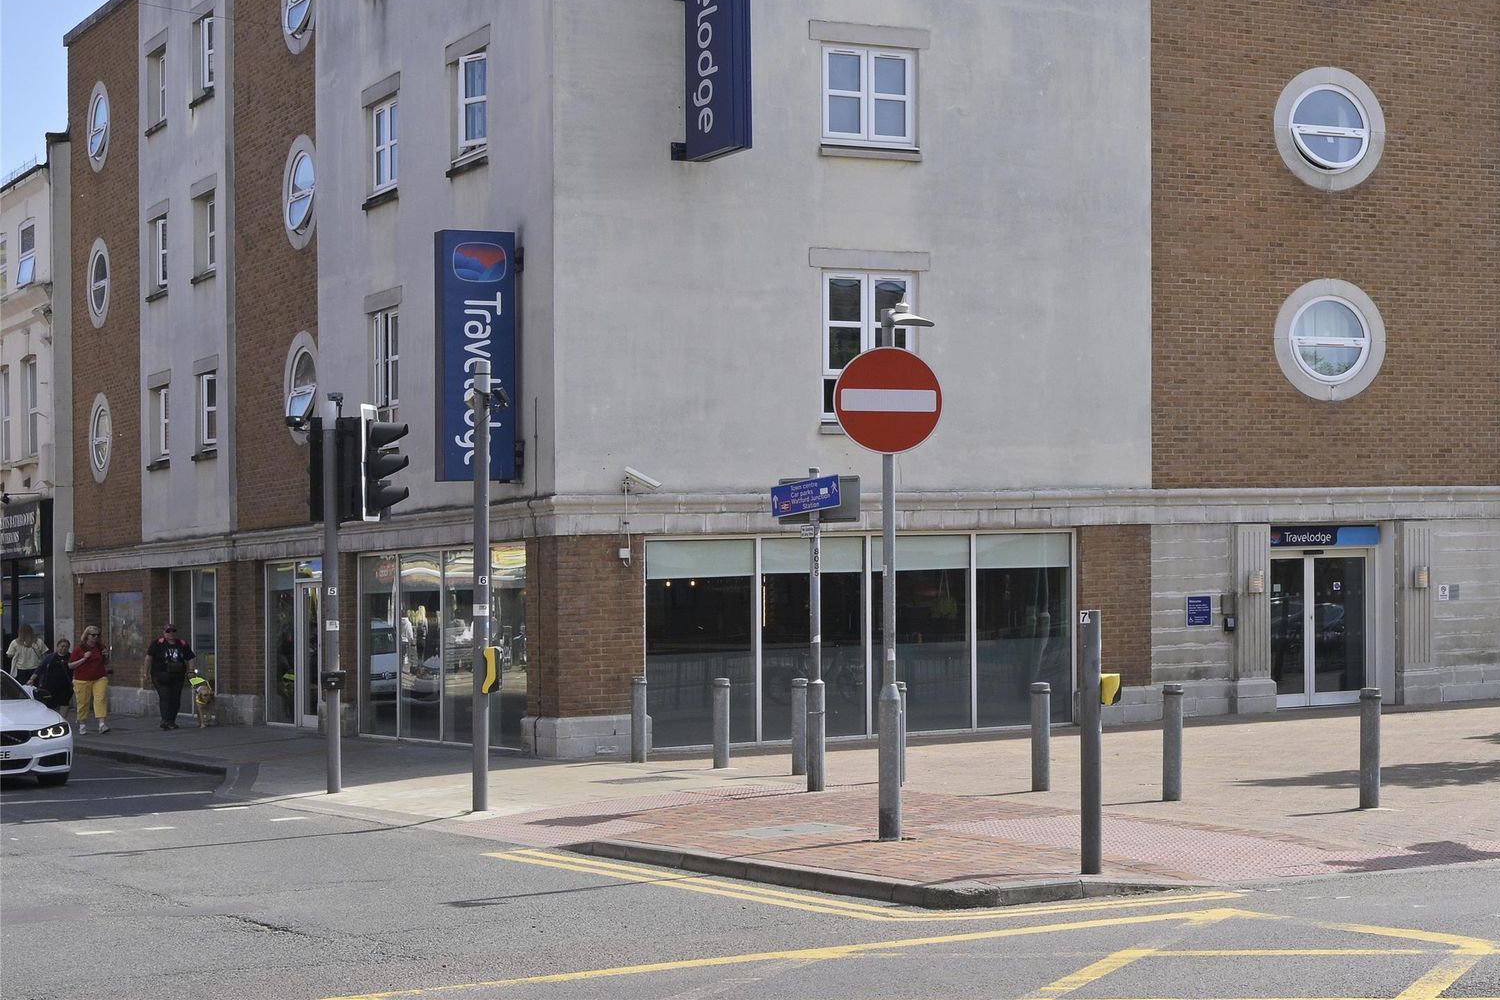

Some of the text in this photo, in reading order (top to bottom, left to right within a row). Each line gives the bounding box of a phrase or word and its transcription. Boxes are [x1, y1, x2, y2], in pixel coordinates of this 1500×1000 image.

[790, 481, 818, 492] Town centre
[790, 489, 814, 499] Car parks
[790, 493, 831, 505] Watford Junction
[802, 502, 820, 510] Station
[1284, 531, 1332, 544] Travelodge
[480, 576, 487, 585] 6
[329, 587, 336, 595] 5
[1081, 611, 1088, 623] 7
